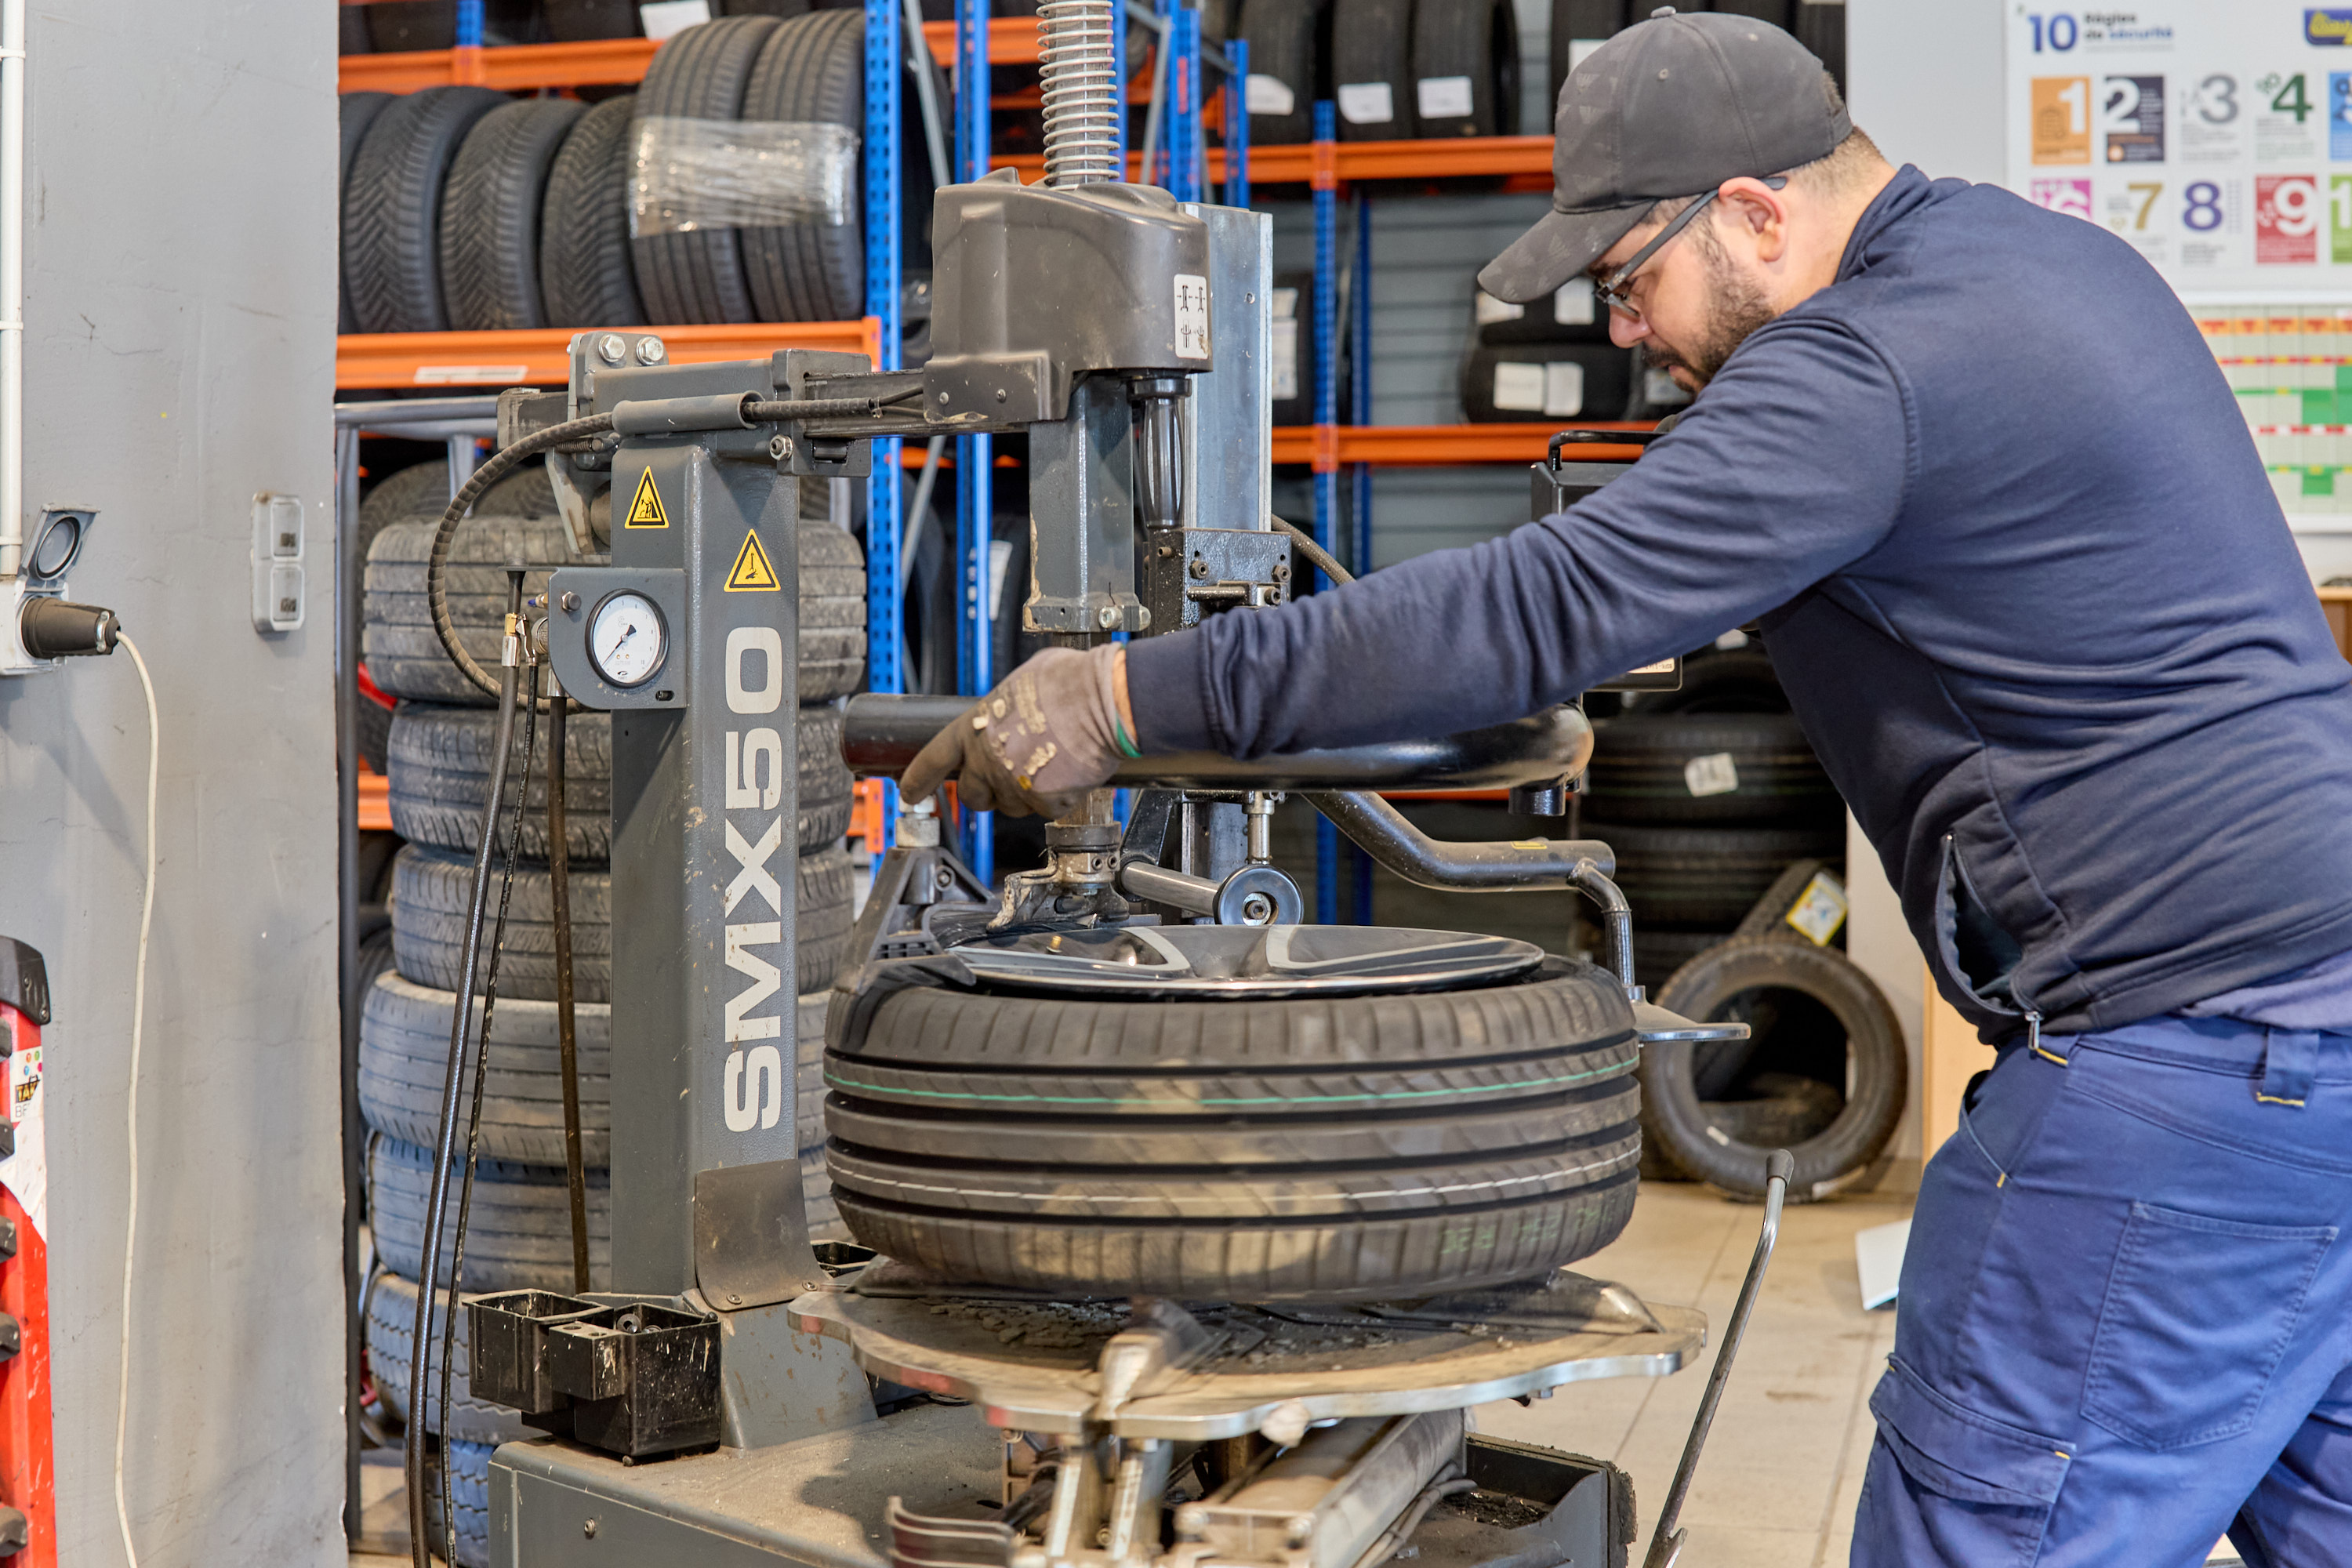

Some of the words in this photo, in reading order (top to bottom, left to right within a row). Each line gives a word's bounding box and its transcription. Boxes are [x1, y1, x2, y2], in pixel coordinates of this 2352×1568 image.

[2027, 14, 2078, 53] 10
[2059, 80, 2086, 134] 1
[2104, 78, 2141, 133] 2
[2200, 74, 2238, 124] 3
[2271, 74, 2313, 122] 4
[2128, 183, 2163, 230] 7
[2183, 181, 2223, 231] 8
[2275, 180, 2317, 236] 9
[724, 627, 782, 1132] SMX50
